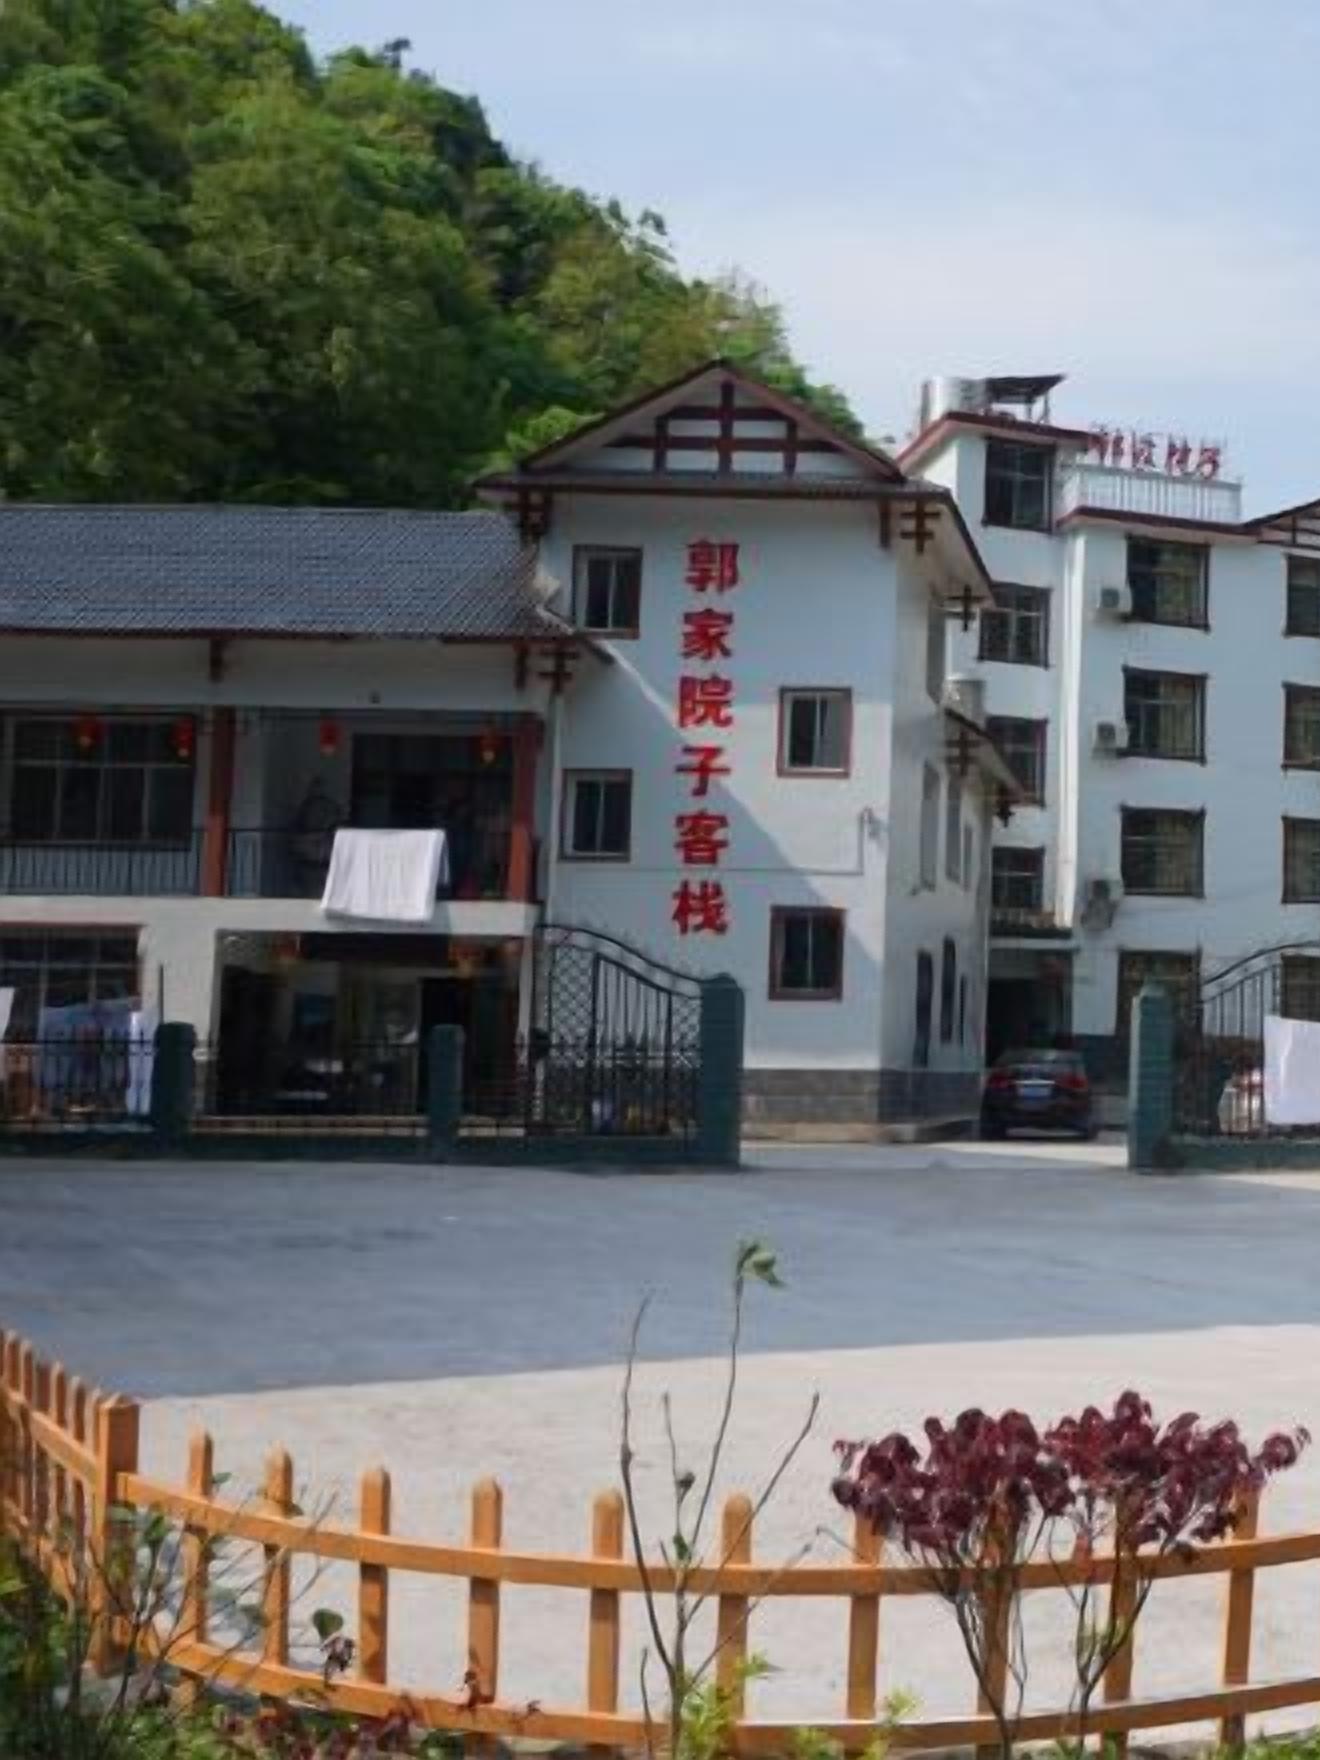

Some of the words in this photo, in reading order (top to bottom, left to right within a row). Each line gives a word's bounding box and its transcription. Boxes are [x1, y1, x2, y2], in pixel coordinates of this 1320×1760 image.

[671, 540, 740, 936] 郭家院子客栈
